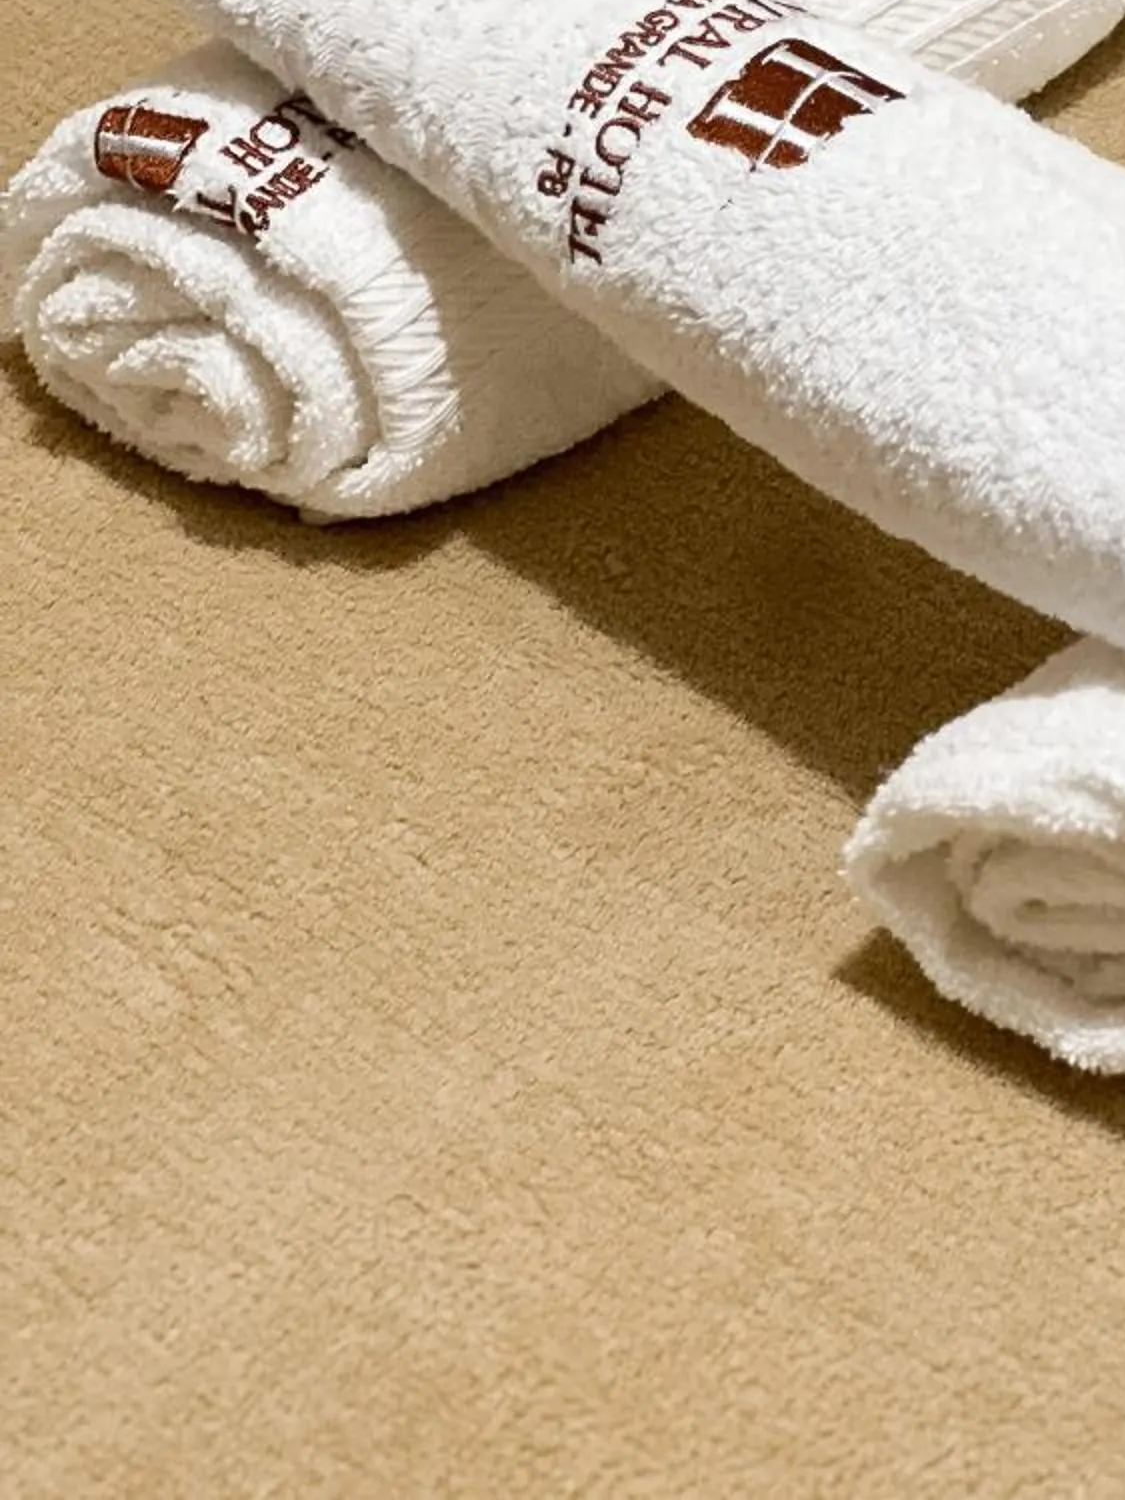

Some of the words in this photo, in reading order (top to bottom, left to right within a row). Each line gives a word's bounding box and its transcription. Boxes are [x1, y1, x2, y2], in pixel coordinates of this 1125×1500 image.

[568, 9, 681, 120] GRANDE
[536, 146, 576, 198] PB
[568, 80, 673, 265] HOTEL
